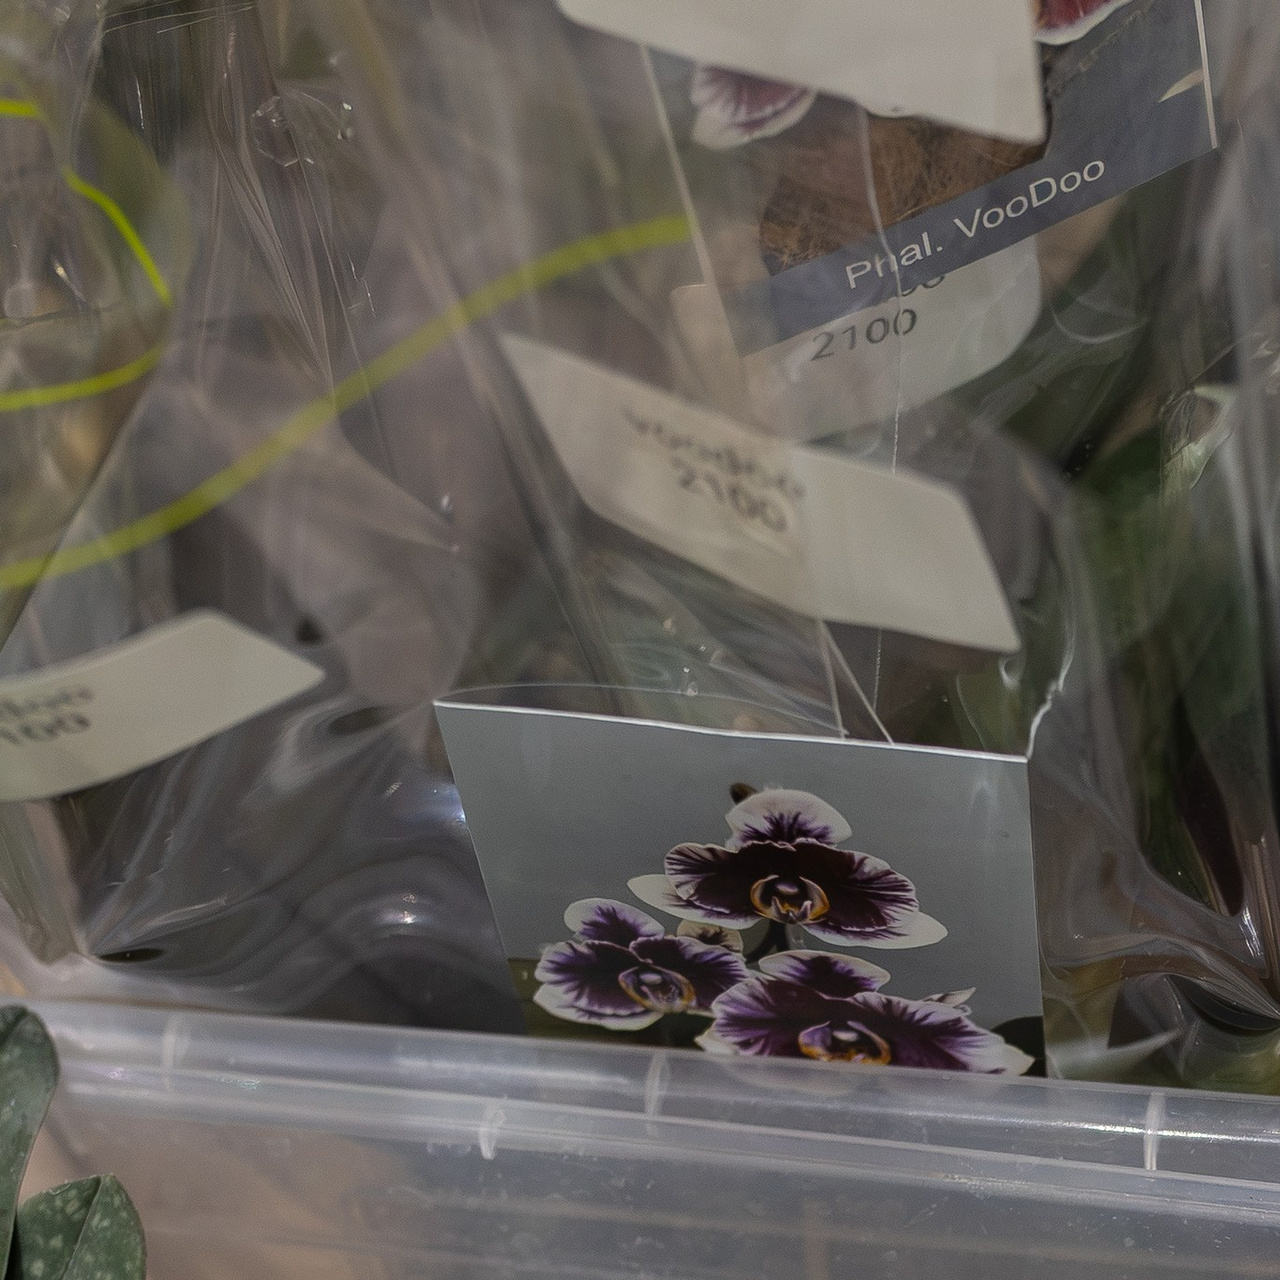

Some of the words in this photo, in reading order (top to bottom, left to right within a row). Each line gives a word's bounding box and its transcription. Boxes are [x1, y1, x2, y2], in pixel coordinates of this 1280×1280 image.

[845, 231, 944, 291] Phal.
[954, 158, 1107, 240] VooDoo
[810, 307, 918, 363] 2100
[670, 455, 789, 533] 2100
